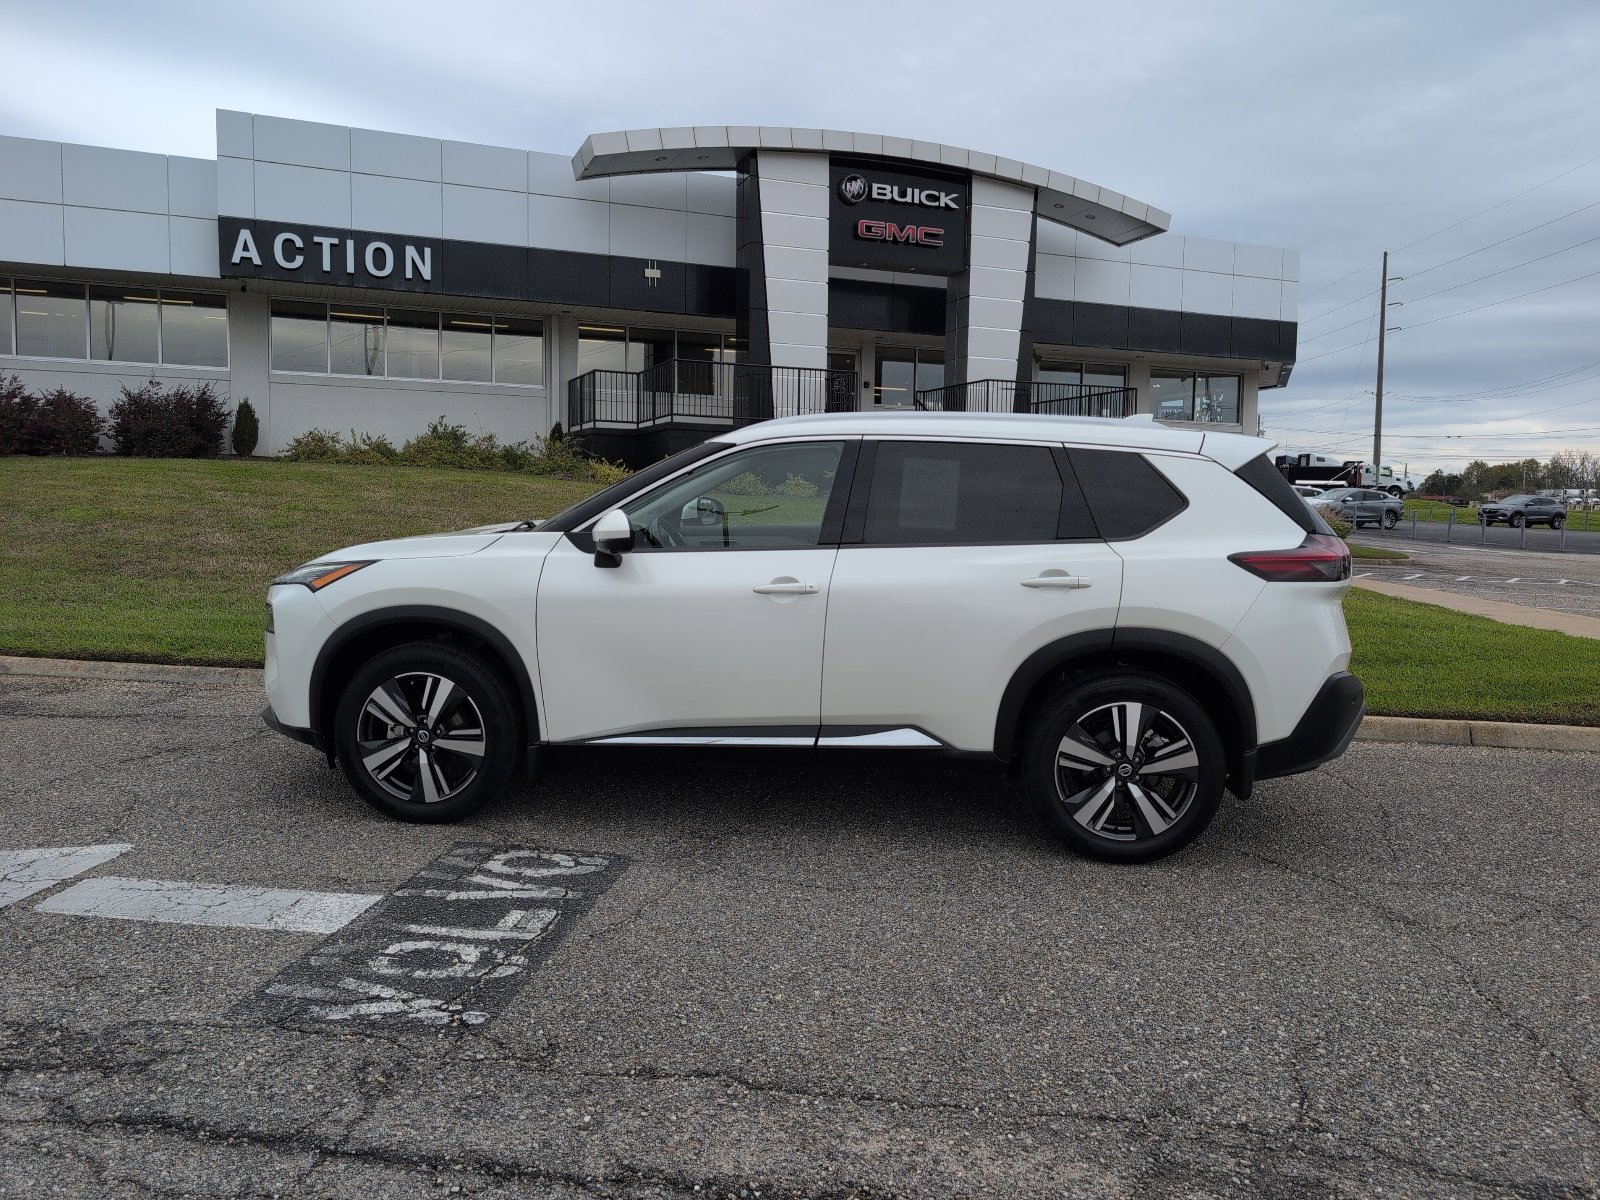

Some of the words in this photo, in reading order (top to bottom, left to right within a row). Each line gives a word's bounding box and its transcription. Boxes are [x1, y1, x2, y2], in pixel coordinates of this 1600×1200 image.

[871, 182, 960, 209] BUICK
[857, 219, 945, 247] GMC
[231, 228, 432, 281] ACTION
[300, 848, 612, 1026] VOLVO
